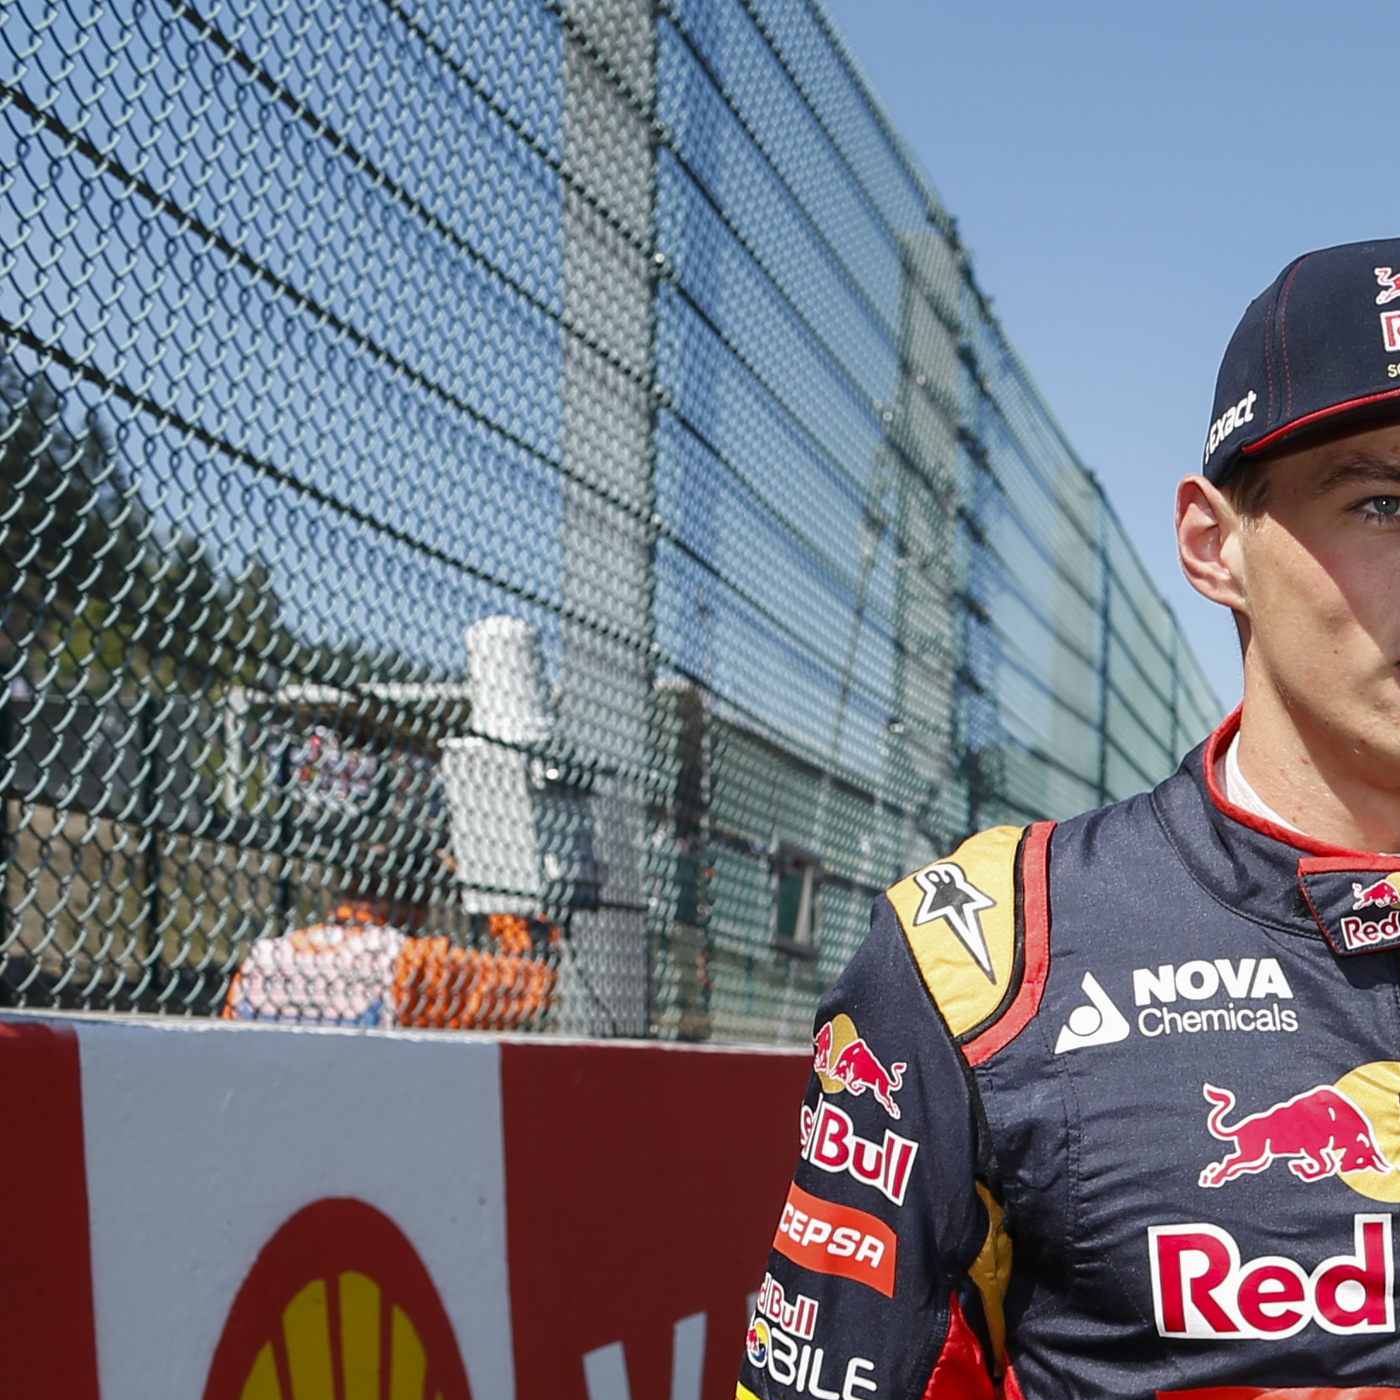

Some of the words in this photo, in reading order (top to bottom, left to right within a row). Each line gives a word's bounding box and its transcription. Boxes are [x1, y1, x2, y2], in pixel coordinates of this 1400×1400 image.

[1342, 908, 1400, 949] Red
[1133, 959, 1294, 1003] NOVA
[1137, 1007, 1298, 1036] Chemicals
[809, 1101, 919, 1206] Bull
[779, 1202, 885, 1268] CEPSA
[1148, 1213, 1396, 1340] Red
[766, 1279, 819, 1341] Bull
